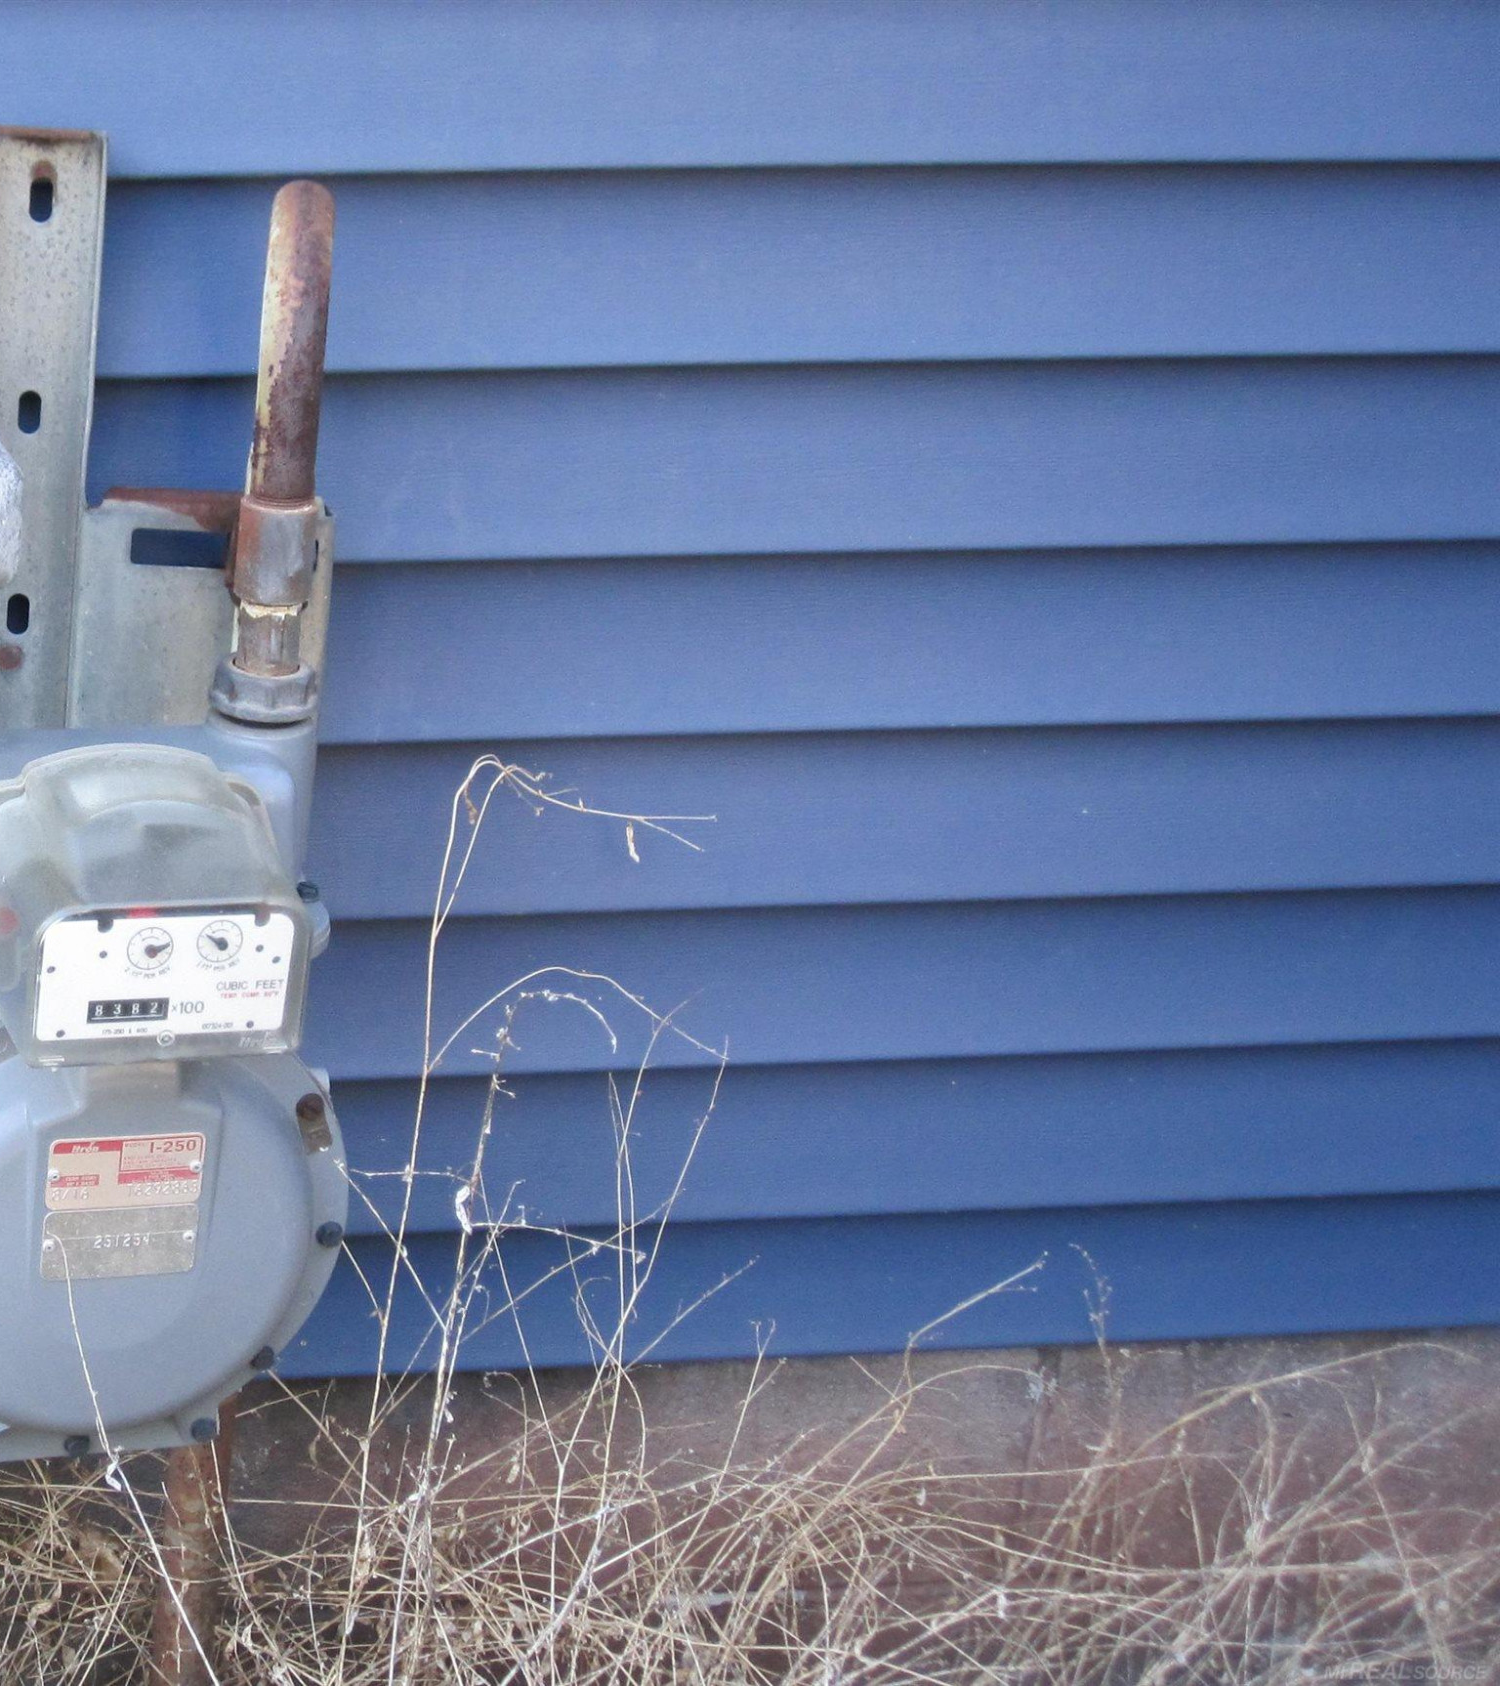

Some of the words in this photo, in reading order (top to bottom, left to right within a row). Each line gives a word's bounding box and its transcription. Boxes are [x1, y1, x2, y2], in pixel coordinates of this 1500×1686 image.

[216, 980, 248, 991] CUBIC
[255, 979, 285, 990] FEET
[94, 1001, 159, 1016] 8382
[150, 1139, 197, 1153] I-250
